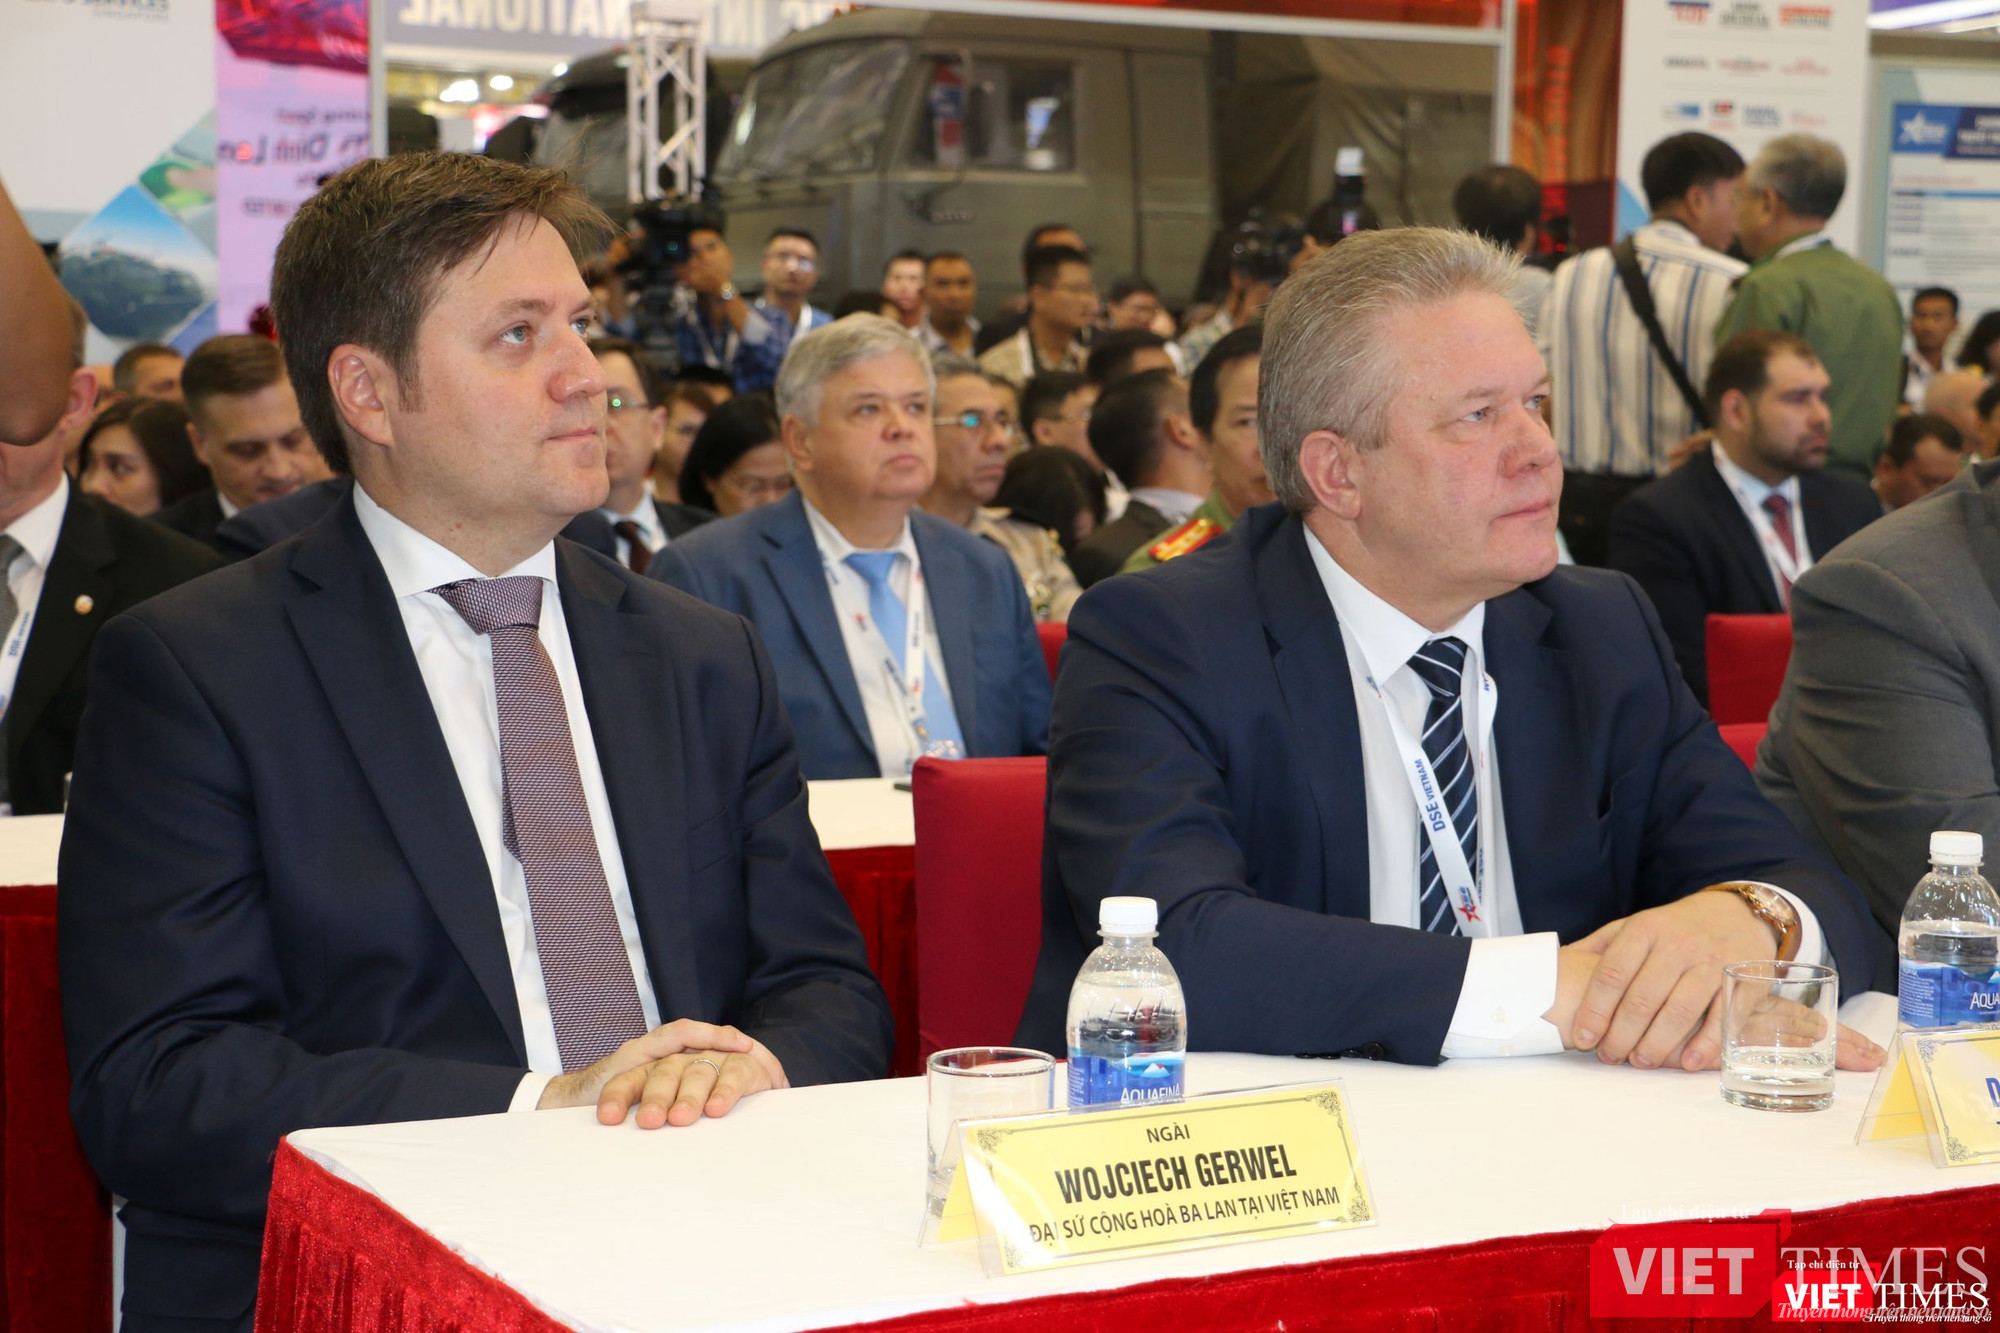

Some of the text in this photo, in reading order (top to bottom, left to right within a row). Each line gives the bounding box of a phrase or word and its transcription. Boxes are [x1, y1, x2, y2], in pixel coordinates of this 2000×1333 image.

[1414, 758, 1446, 832] DSE VIETNAM
[1146, 1122, 1190, 1143] NGÀI
[1054, 1144, 1297, 1204] WOJCIECH GERWEL
[1029, 1186, 1340, 1246] ĐẠI SỨ CỘNG HOÀ BA LAN TẠI VIỆT NAM
